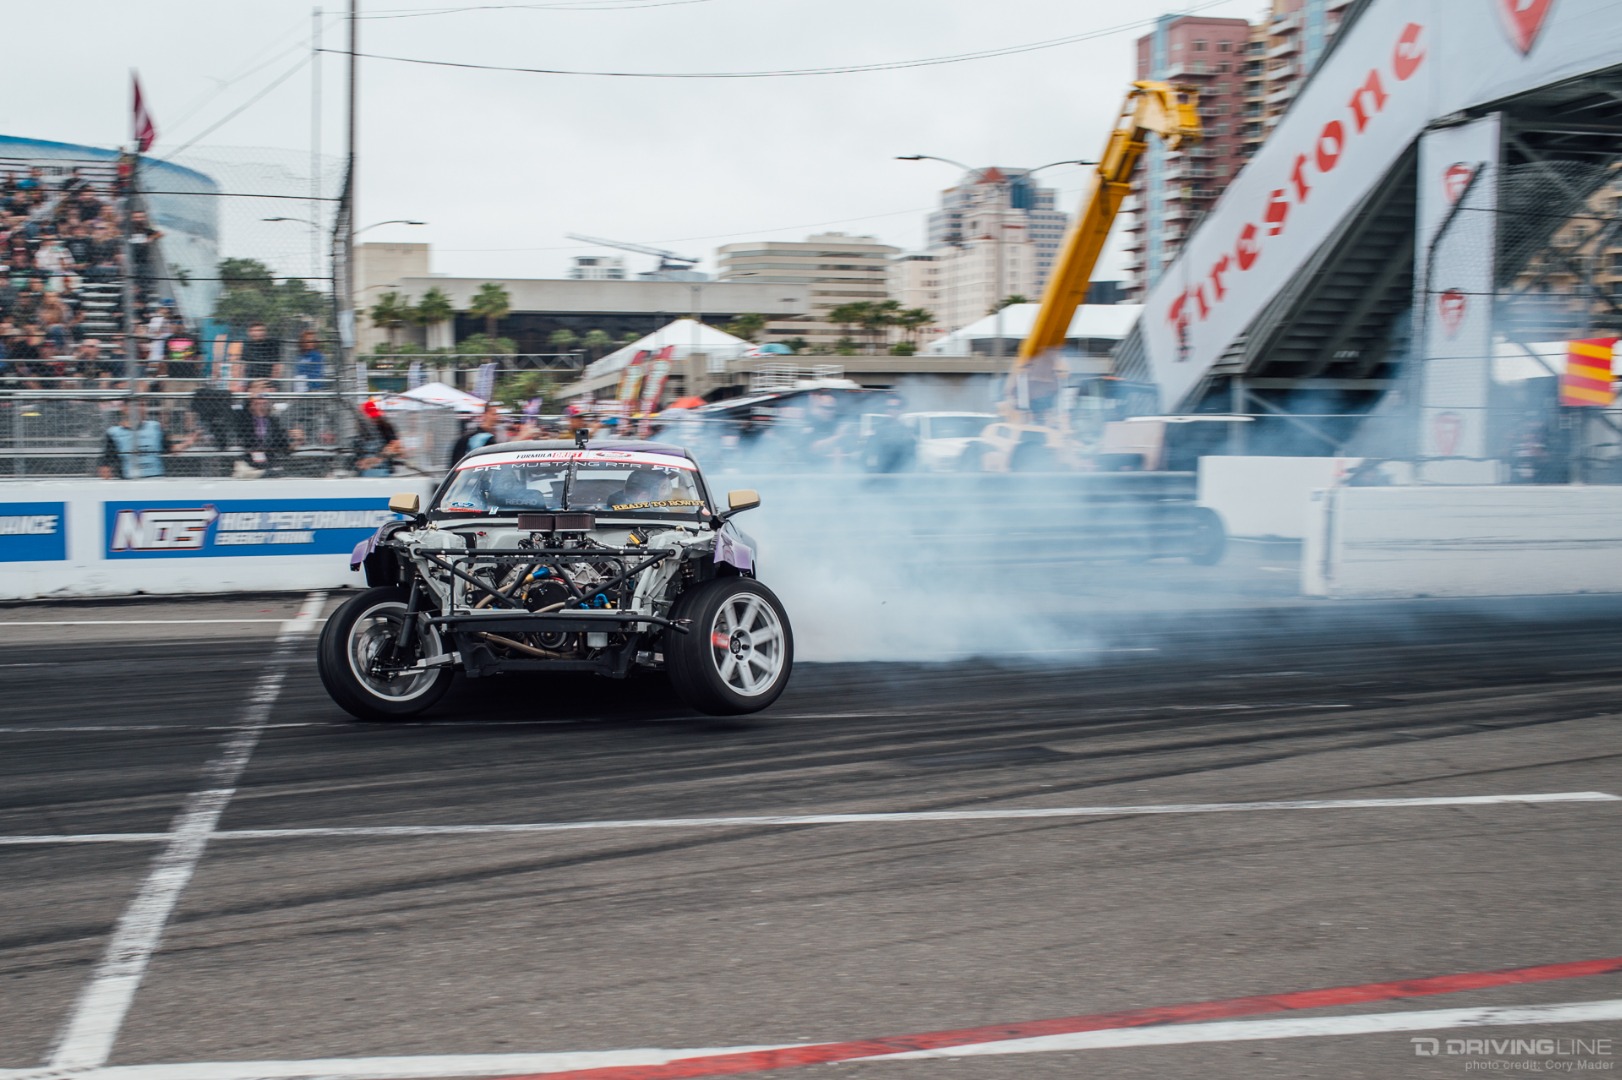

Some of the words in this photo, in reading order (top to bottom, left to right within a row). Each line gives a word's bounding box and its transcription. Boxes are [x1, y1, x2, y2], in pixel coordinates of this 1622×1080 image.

[1166, 22, 1426, 362] Firestone
[511, 461, 600, 469] MUSTANG
[612, 502, 650, 511] READY
[668, 499, 705, 508] ROWDY
